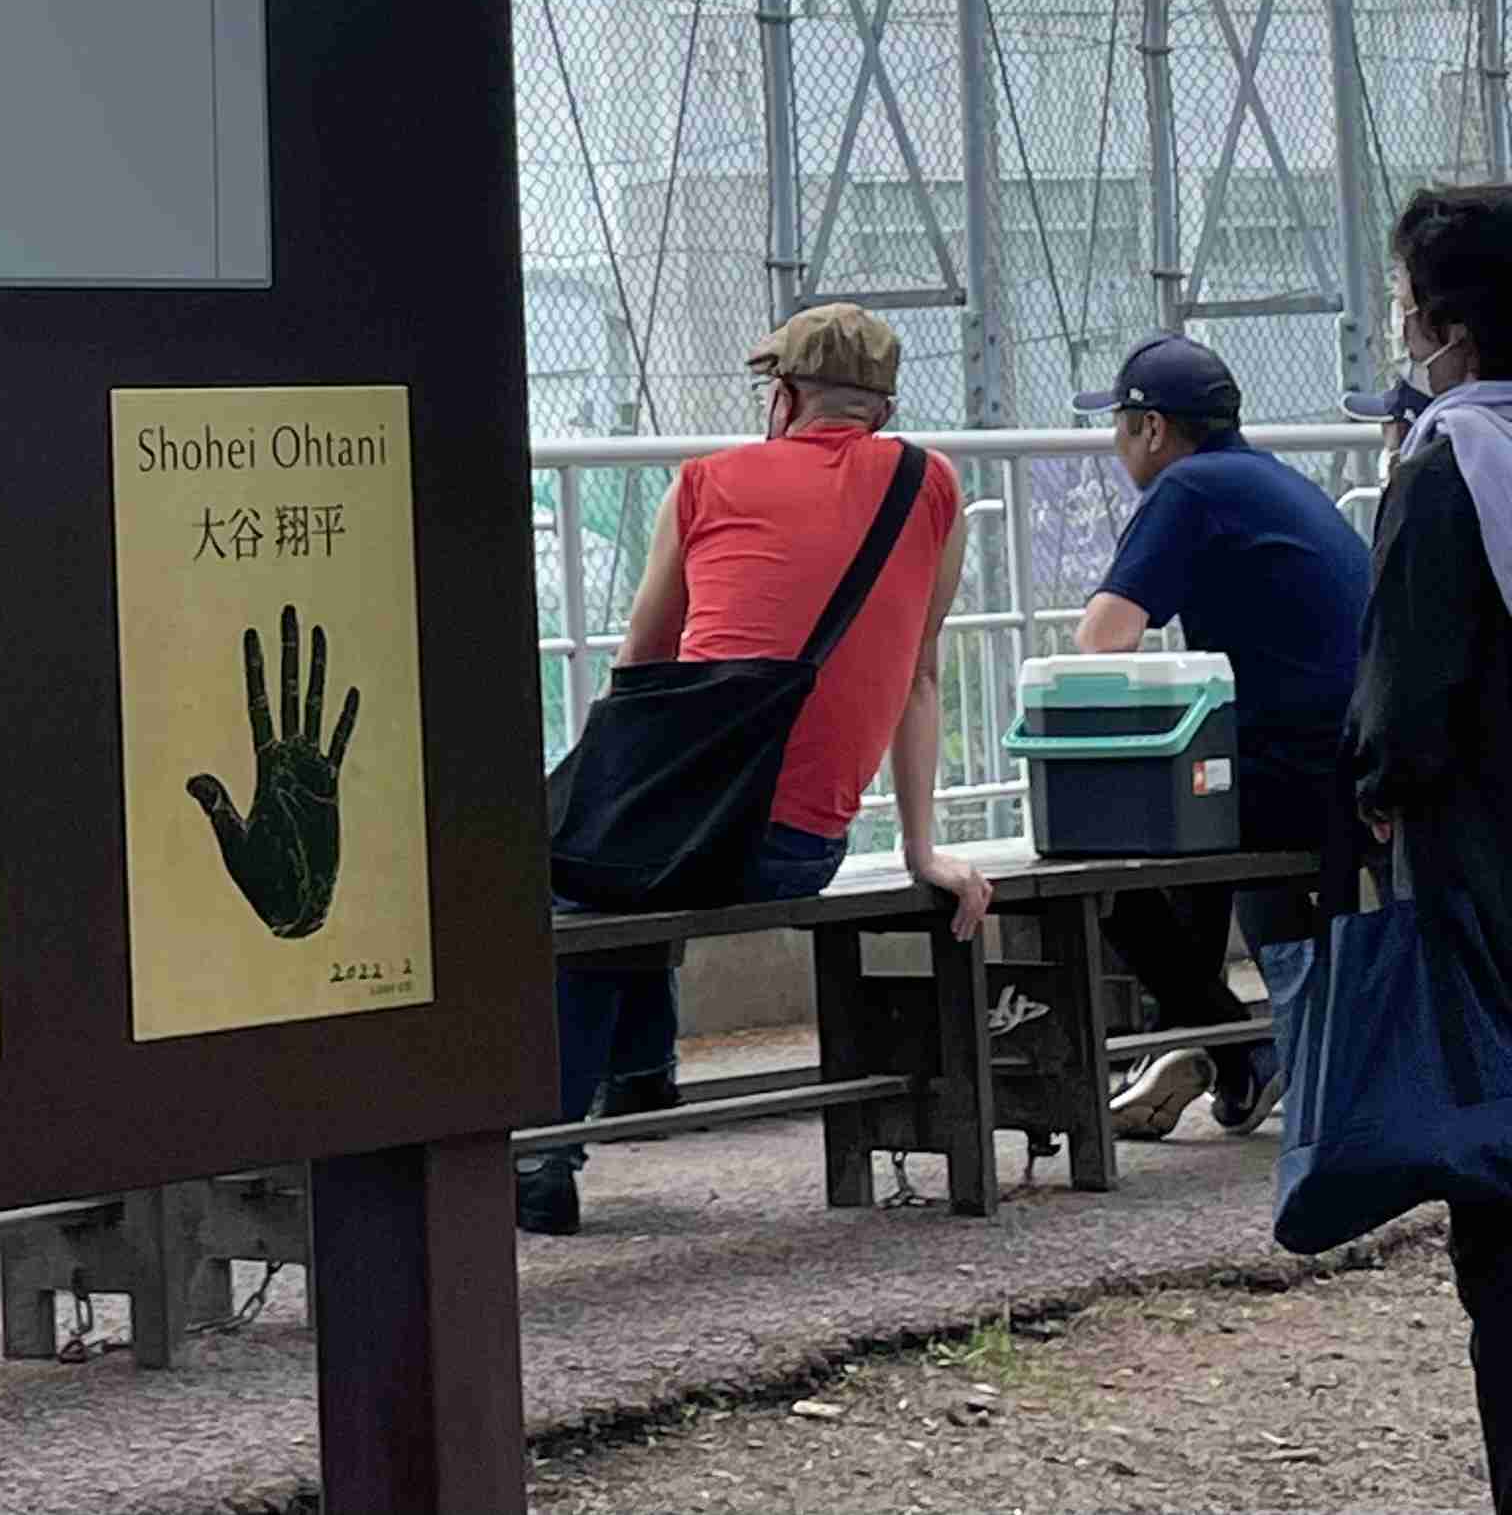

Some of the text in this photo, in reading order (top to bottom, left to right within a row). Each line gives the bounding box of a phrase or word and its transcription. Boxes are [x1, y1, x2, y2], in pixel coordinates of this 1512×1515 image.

[138, 423, 387, 473] Shohei Ohtani
[191, 504, 347, 562] 大谷 翔平
